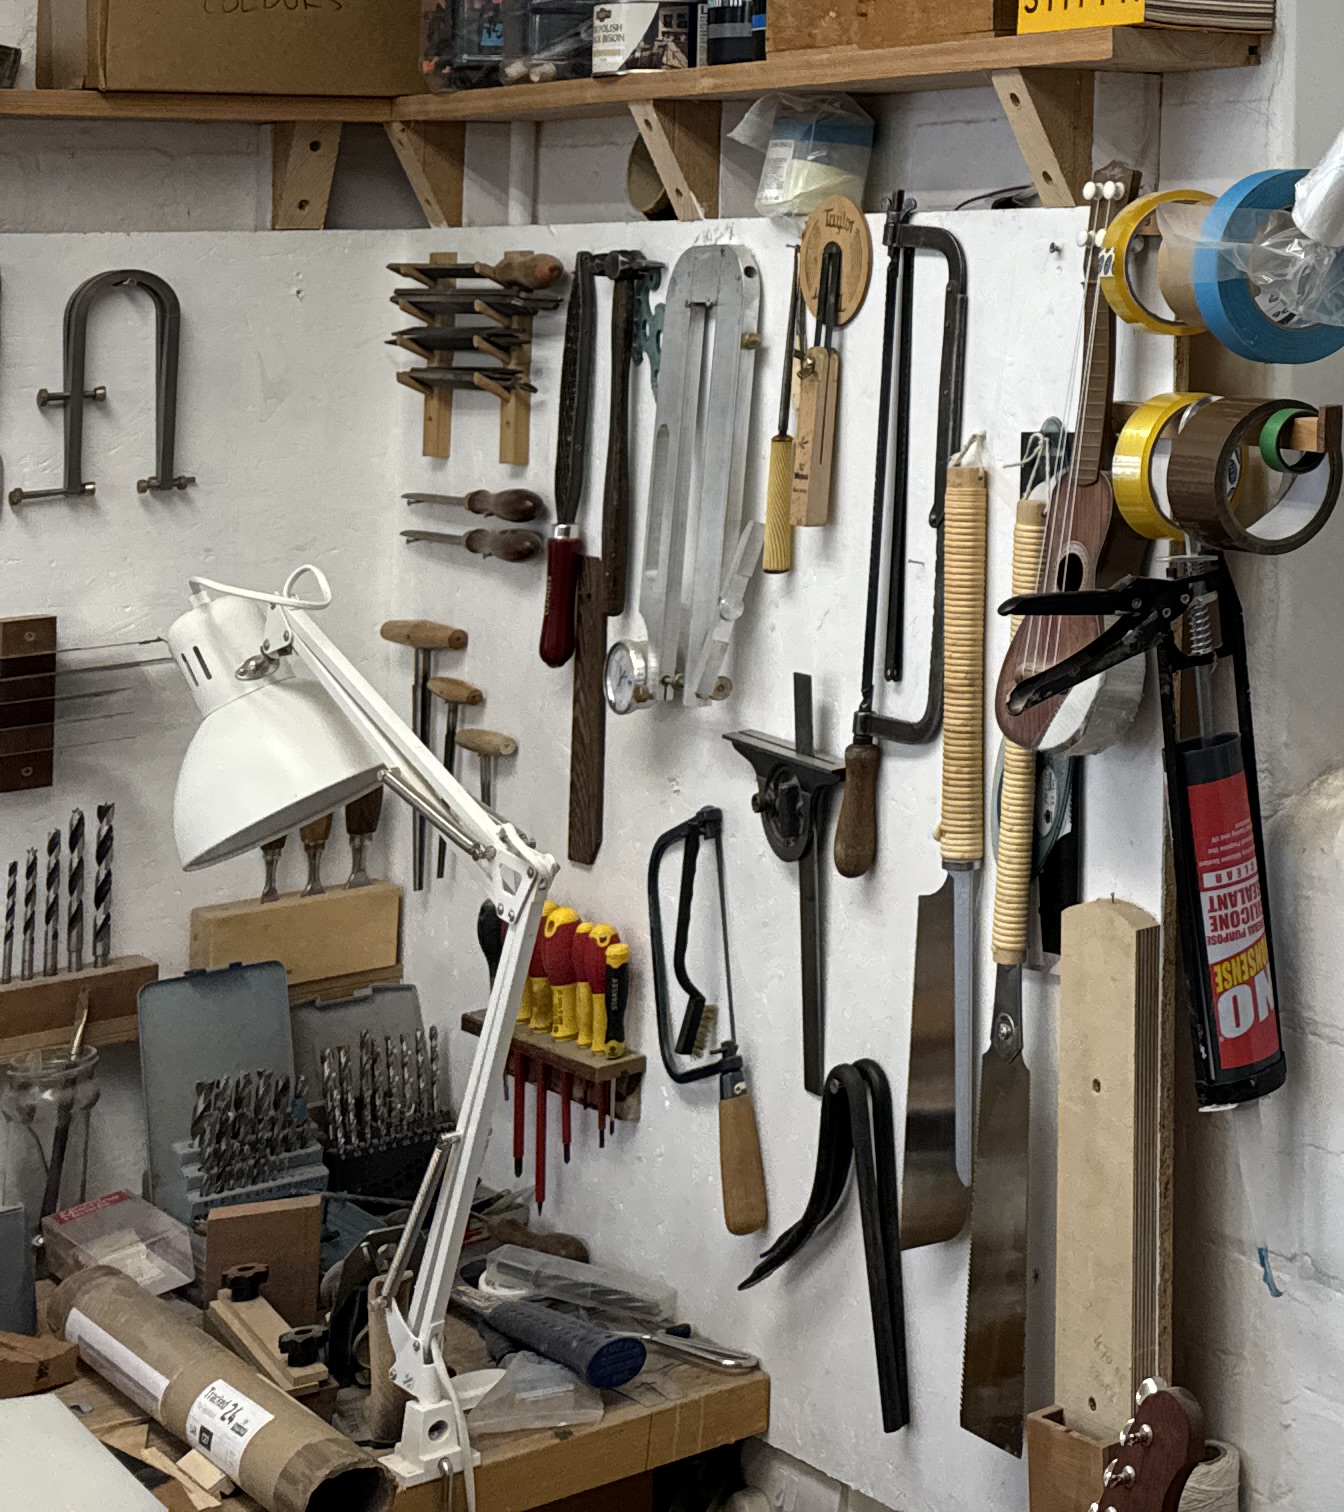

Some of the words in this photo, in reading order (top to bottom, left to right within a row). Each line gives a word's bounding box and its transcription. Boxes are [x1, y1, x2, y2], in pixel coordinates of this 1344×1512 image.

[824, 207, 855, 234] Taylor
[1215, 861, 1256, 884] CLEAR
[204, 1386, 232, 1411] Tracked
